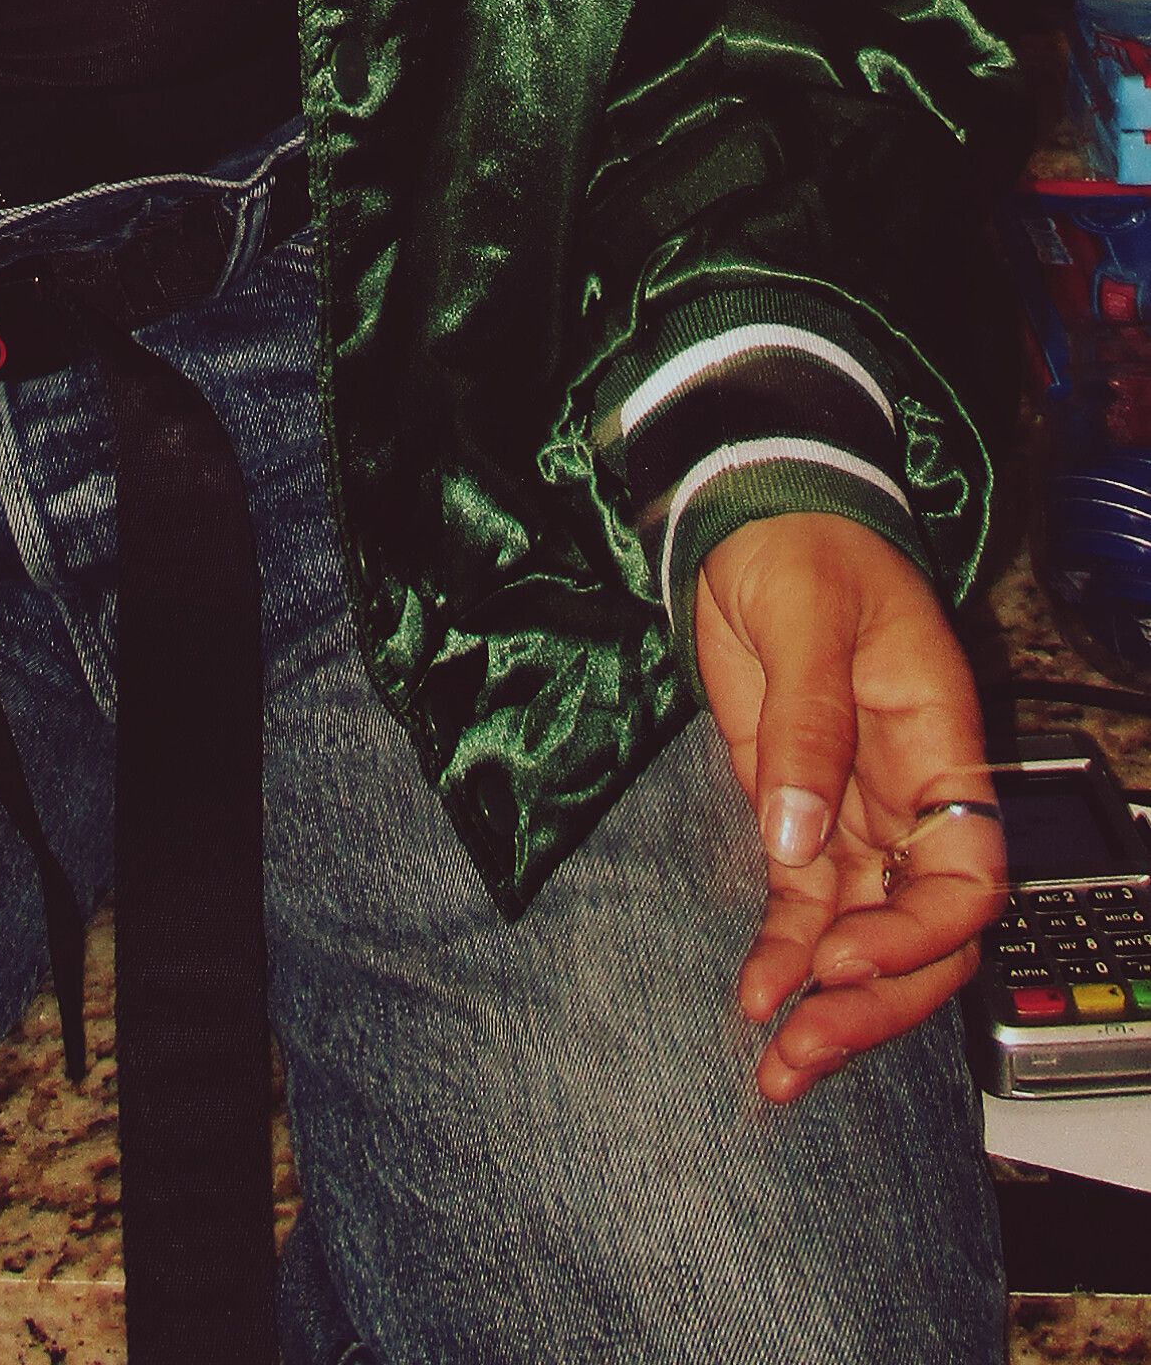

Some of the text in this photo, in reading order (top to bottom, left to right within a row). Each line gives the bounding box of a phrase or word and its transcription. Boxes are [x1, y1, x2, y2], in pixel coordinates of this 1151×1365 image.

[1063, 890, 1076, 903] 2
[1121, 887, 1134, 900] 3
[1017, 917, 1028, 929] 4
[1074, 914, 1087, 927] 5
[1133, 910, 1144, 922] 6
[1026, 941, 1037, 954] 7
[1085, 937, 1098, 950] 8
[1010, 969, 1049, 978] ALPHA
